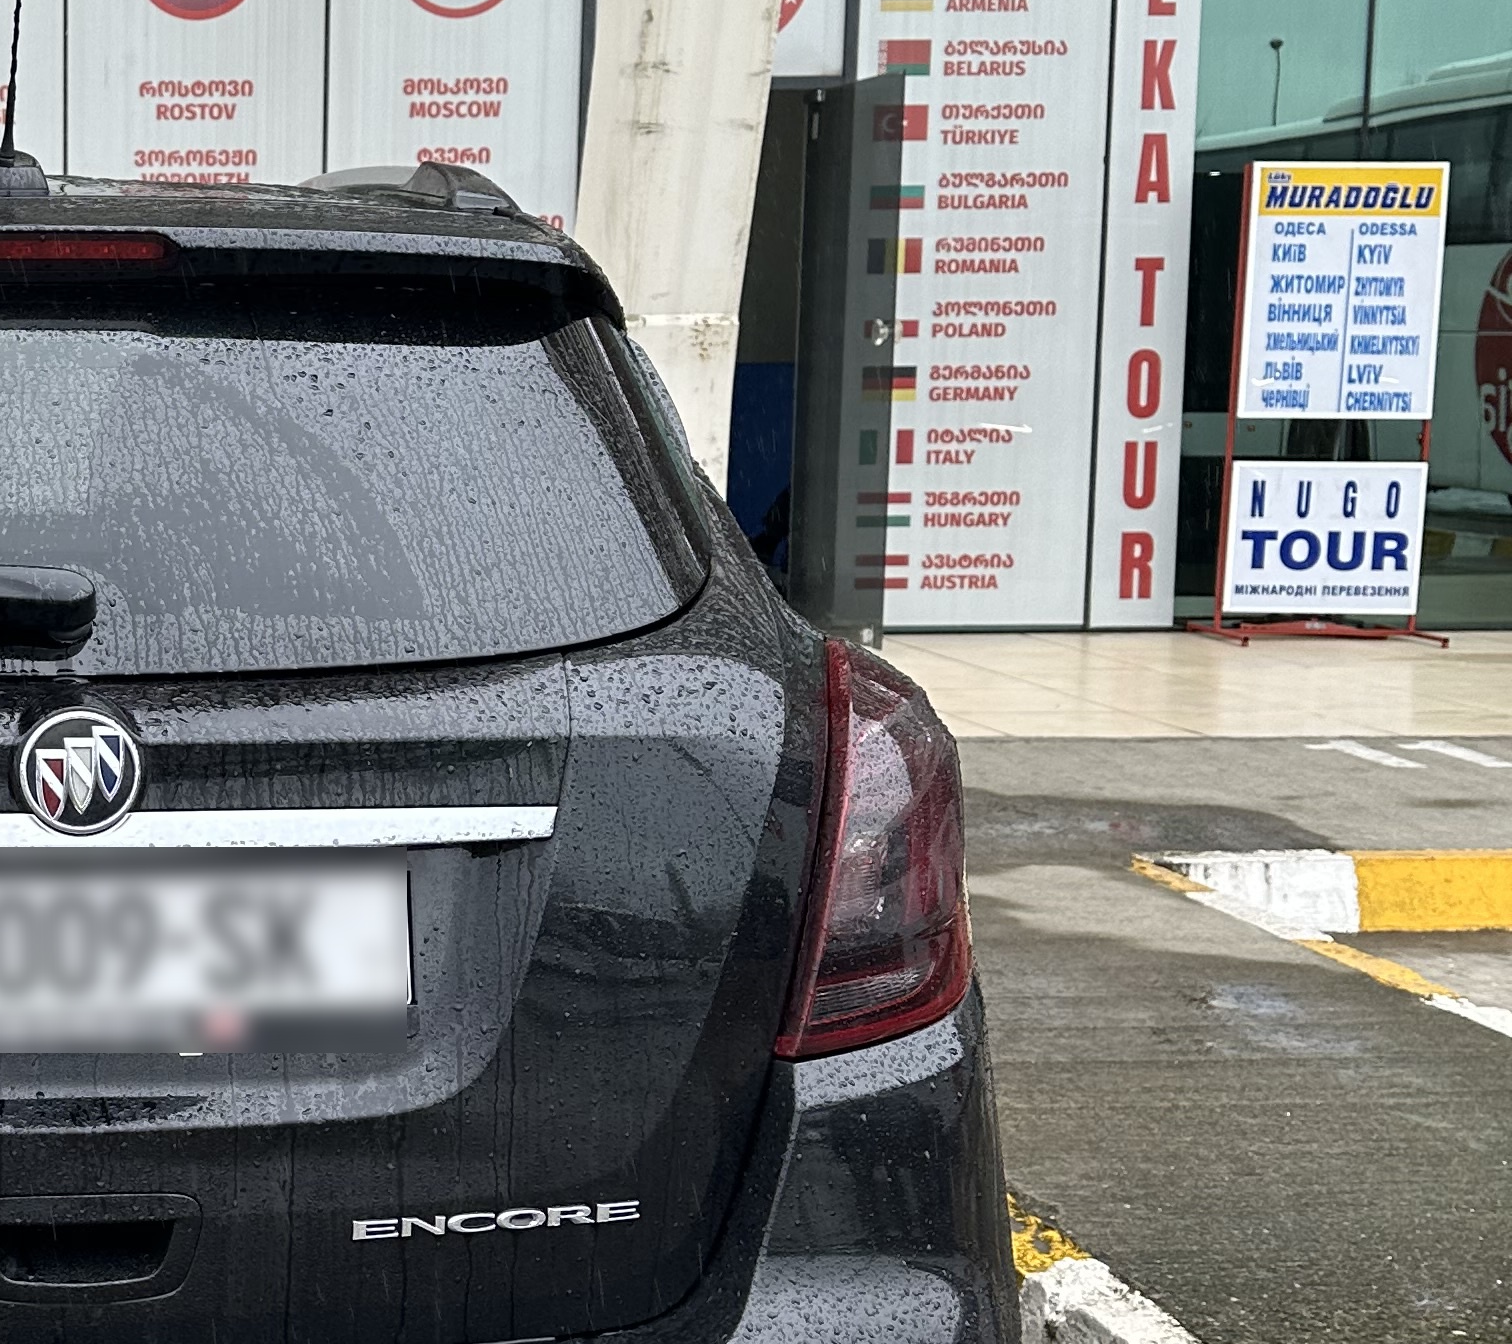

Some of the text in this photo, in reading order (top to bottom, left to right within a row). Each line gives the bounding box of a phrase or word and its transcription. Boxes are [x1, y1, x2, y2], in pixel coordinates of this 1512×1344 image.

[944, 40, 1068, 56] ბელარუსია
[943, 60, 1026, 76] BELARUS
[139, 80, 254, 97] როსტოვი
[403, 77, 509, 95] მოსკოვი
[156, 103, 236, 120] ROSTOV
[409, 101, 501, 118] MOSCOW
[941, 104, 1045, 120] თურქეთი
[940, 125, 1019, 145] TÜRKIYE
[134, 149, 257, 166] ვორონეჟი
[938, 172, 1069, 188] ბულგარეთი
[937, 194, 1028, 209] BULGARIA
[1266, 183, 1435, 209] MURADOĞLU
[1274, 222, 1326, 237] ОДЕСА
[1359, 222, 1417, 236] ODESSA
[935, 236, 1045, 253] რუმინეთი
[934, 258, 1019, 274] ROMANIA
[1270, 274, 1345, 294] ЖИТОМИР
[932, 300, 1057, 316] პოლონეთი
[931, 322, 1006, 338] POLAND
[929, 365, 1031, 381] გერმანია
[929, 386, 1019, 402] GERMANY
[927, 428, 1013, 444] იტალია
[1119, 257, 1165, 599] TOUR
[926, 449, 975, 465] ITALY
[924, 491, 1021, 506] უნგრეთი
[1251, 480, 1401, 518] NUGO
[923, 512, 1012, 527] HUNGARY
[1241, 529, 1409, 571] TOUR
[921, 553, 1014, 569] ავსტრია
[920, 575, 998, 589] AUSTRIA
[1235, 584, 1409, 597] МІЖНАРОДНІ ПЕРЕВЕЗЕННЯ
[352, 1200, 640, 1240] ENCORE
